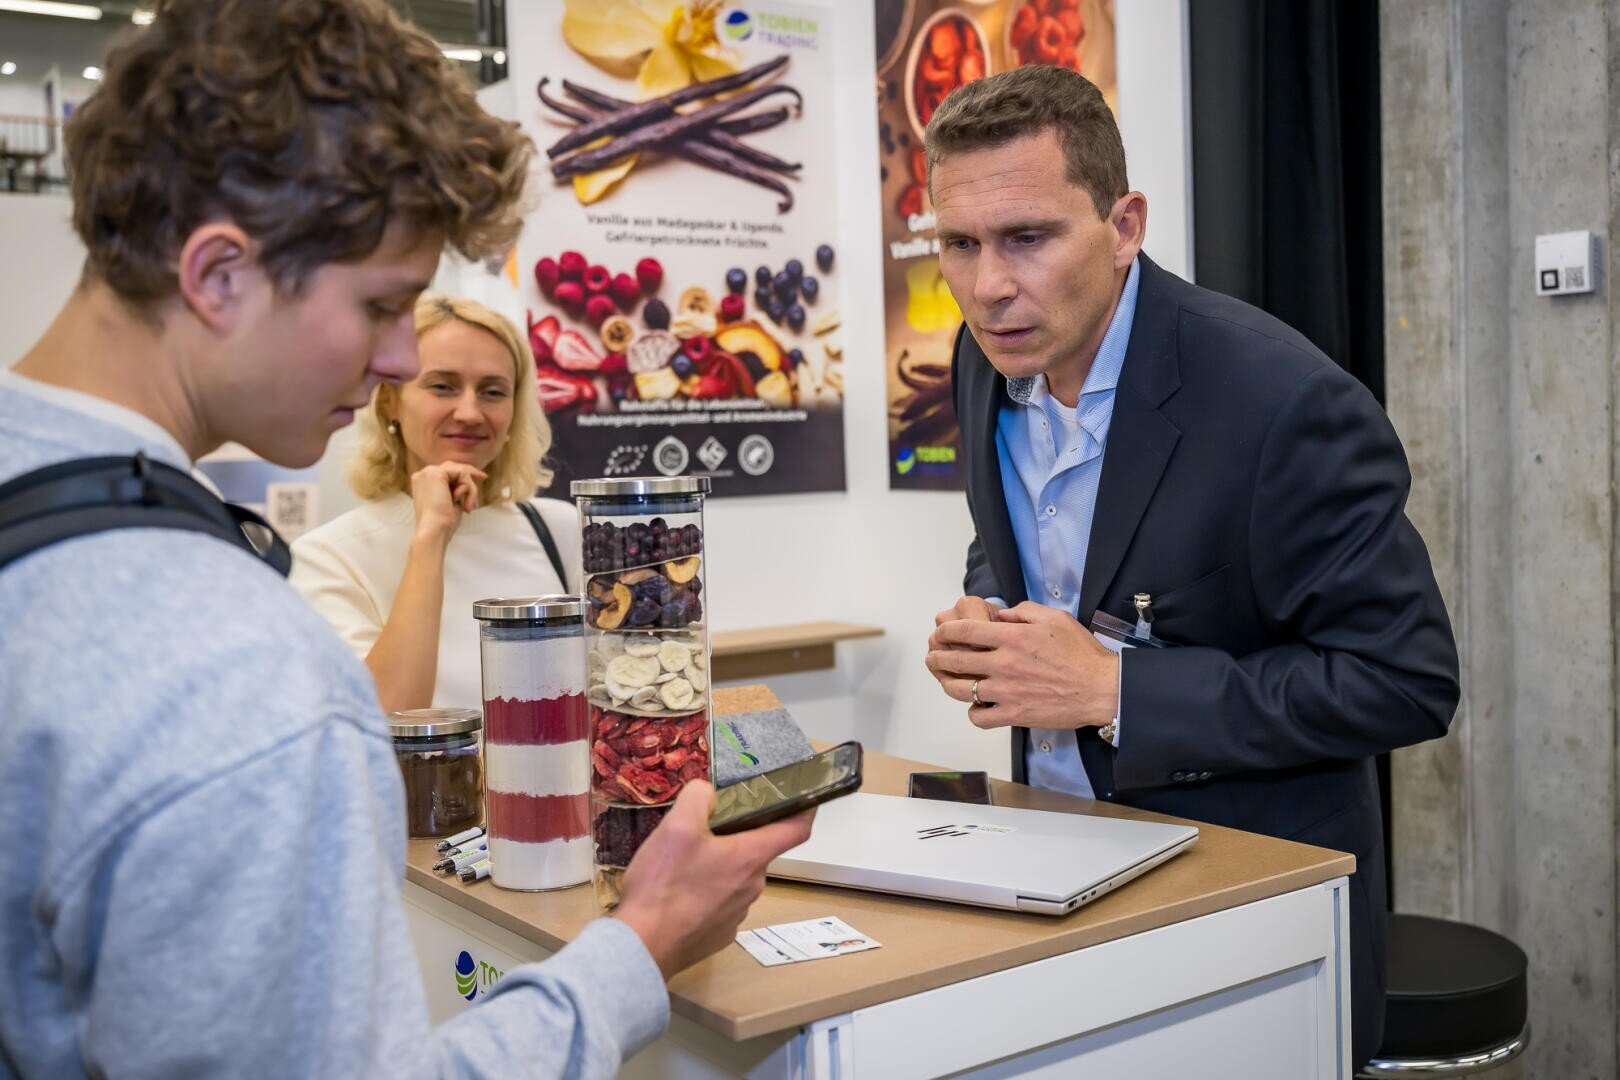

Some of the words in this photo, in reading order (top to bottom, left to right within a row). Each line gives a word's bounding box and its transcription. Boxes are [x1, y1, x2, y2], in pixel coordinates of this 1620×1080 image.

[587, 213, 629, 226] Vanille
[634, 217, 653, 227] aus
[657, 216, 725, 232] Madagaskar
[606, 230, 721, 248] Gefriergetrocknete
[479, 960, 504, 986] TO
